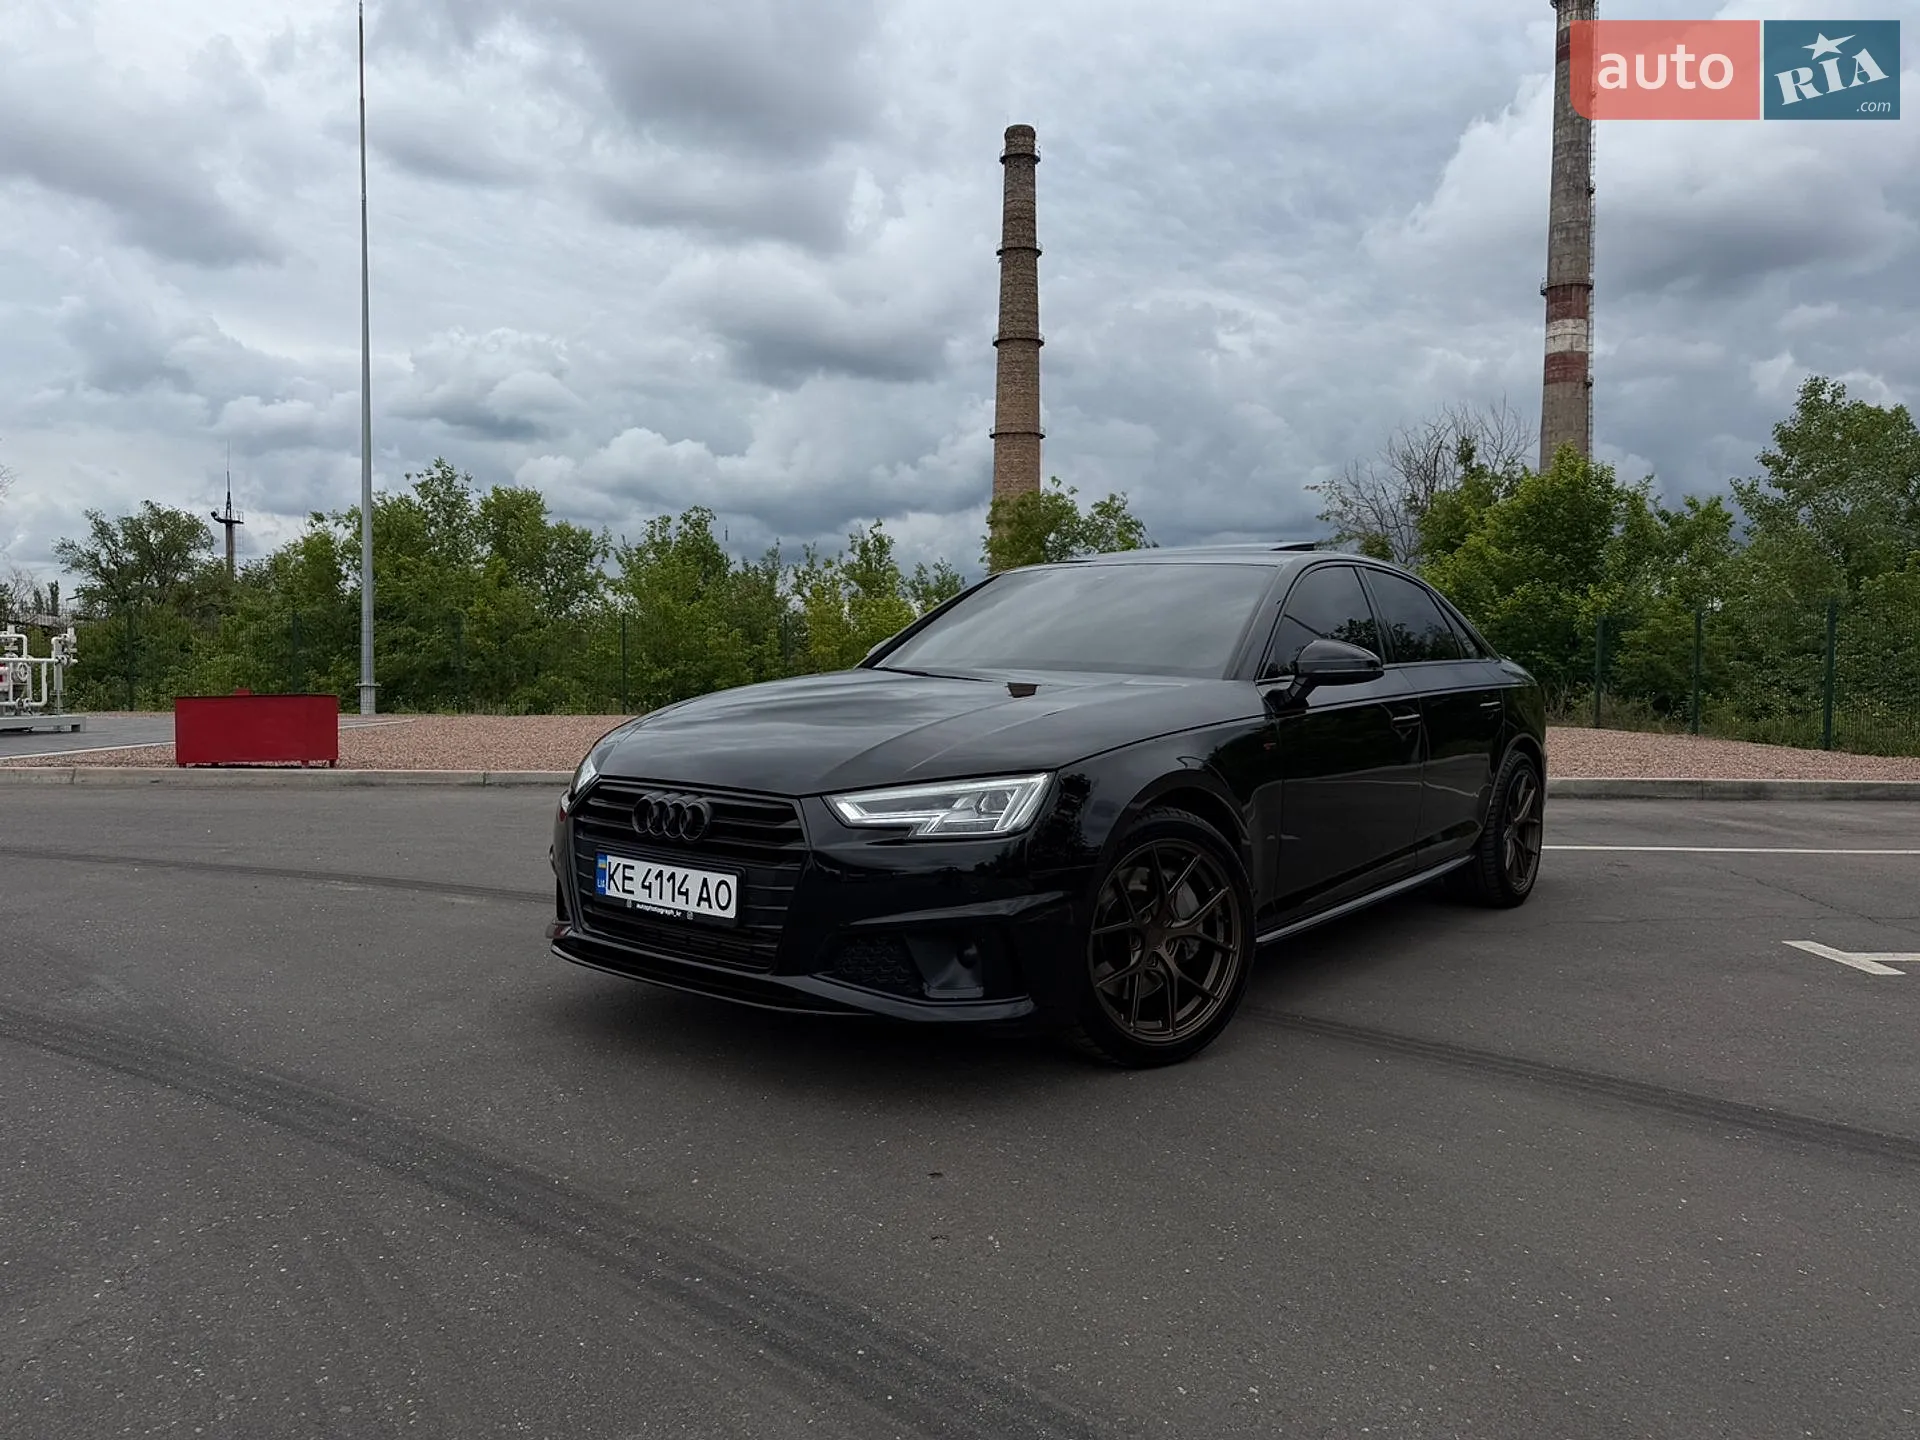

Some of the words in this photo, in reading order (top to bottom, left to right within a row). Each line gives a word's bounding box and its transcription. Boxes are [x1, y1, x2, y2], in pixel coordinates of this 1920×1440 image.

[607, 861, 635, 895] KE
[641, 868, 690, 905] 4114
[696, 877, 732, 911] AO
